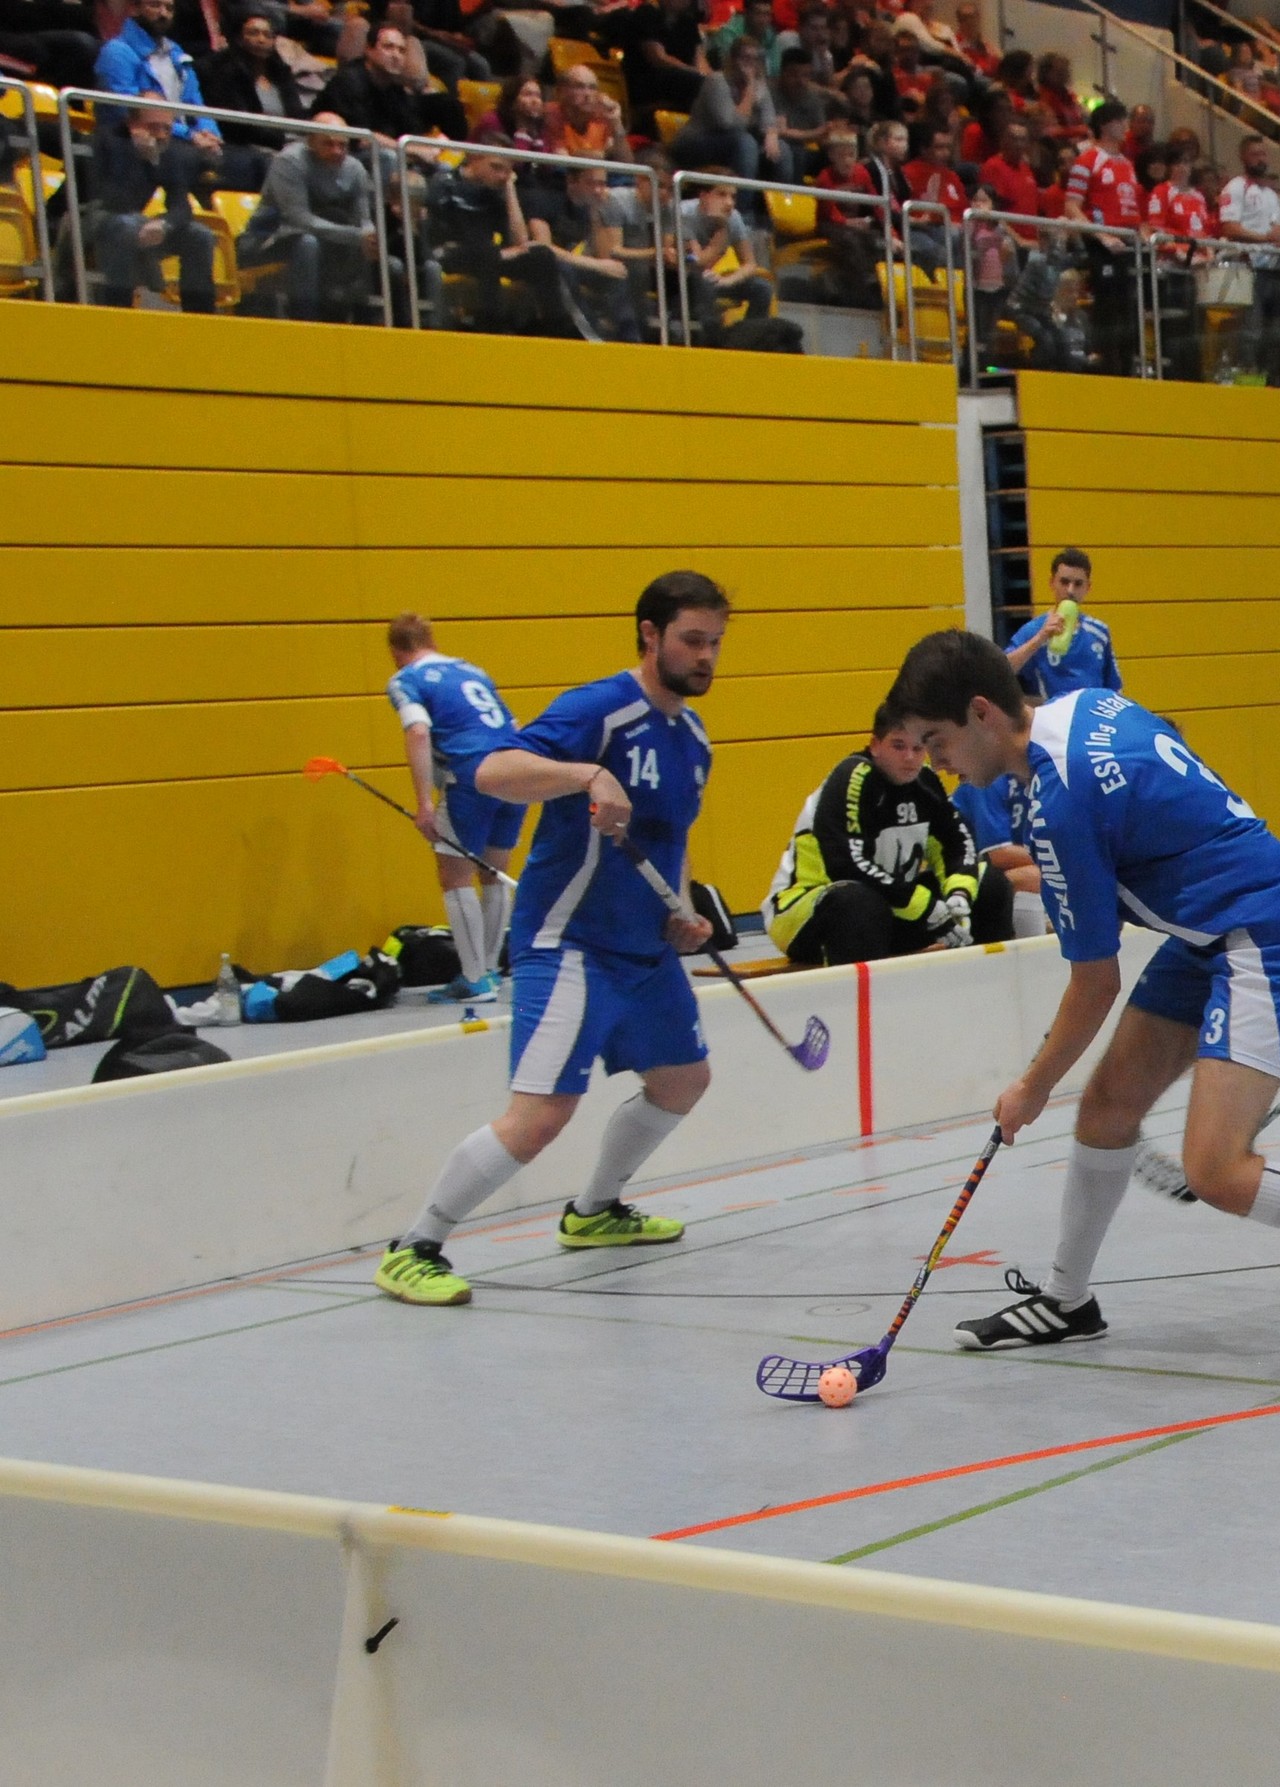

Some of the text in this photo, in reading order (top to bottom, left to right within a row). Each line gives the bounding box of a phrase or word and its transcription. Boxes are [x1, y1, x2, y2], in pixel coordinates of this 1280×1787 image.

[460, 679, 505, 729] 9
[626, 745, 661, 790] 14
[1087, 751, 1127, 795] ESV
[1154, 733, 1257, 819] 3
[896, 801, 918, 823] 98
[1204, 1007, 1226, 1045] 3
